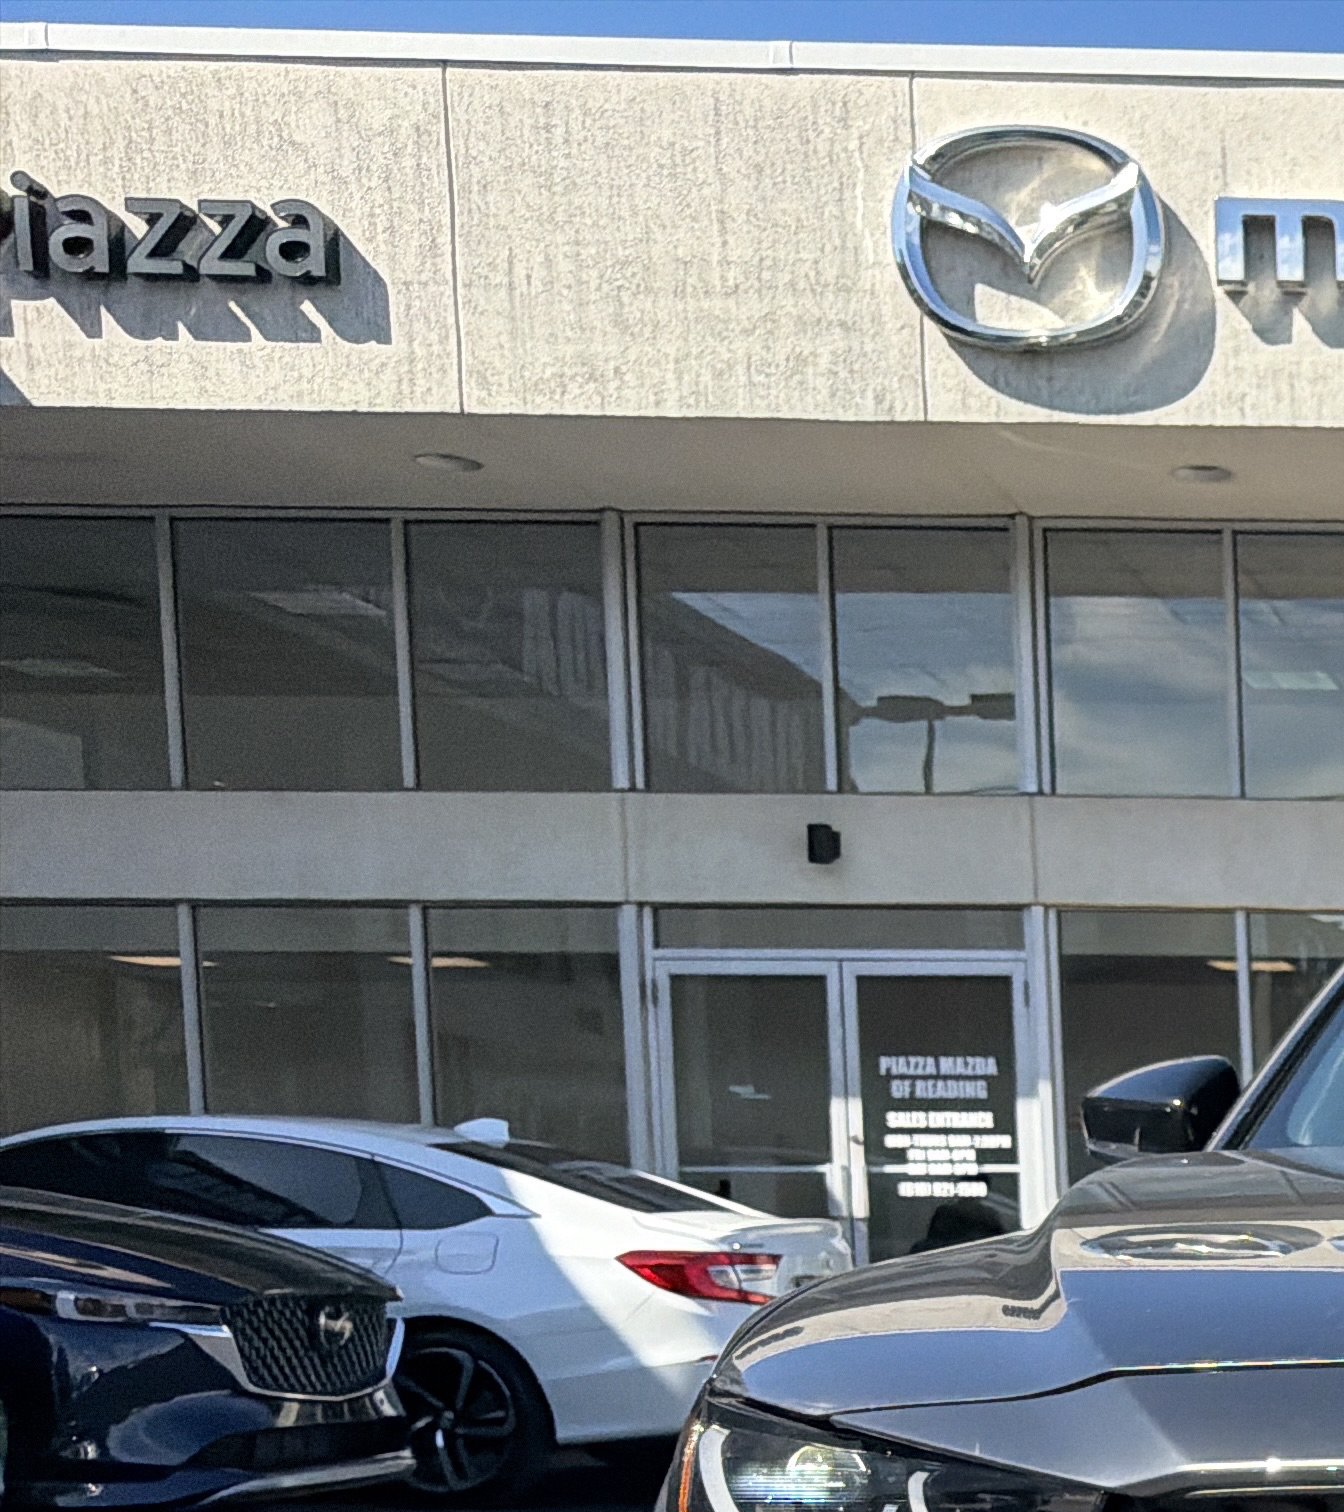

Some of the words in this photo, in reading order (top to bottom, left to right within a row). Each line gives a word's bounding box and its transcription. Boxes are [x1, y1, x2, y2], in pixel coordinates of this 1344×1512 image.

[0, 170, 330, 277] iazza
[879, 1055, 937, 1076] PIAZZA
[938, 1056, 998, 1076] MAZDA
[890, 1079, 912, 1099] OF
[914, 1079, 988, 1099] READING
